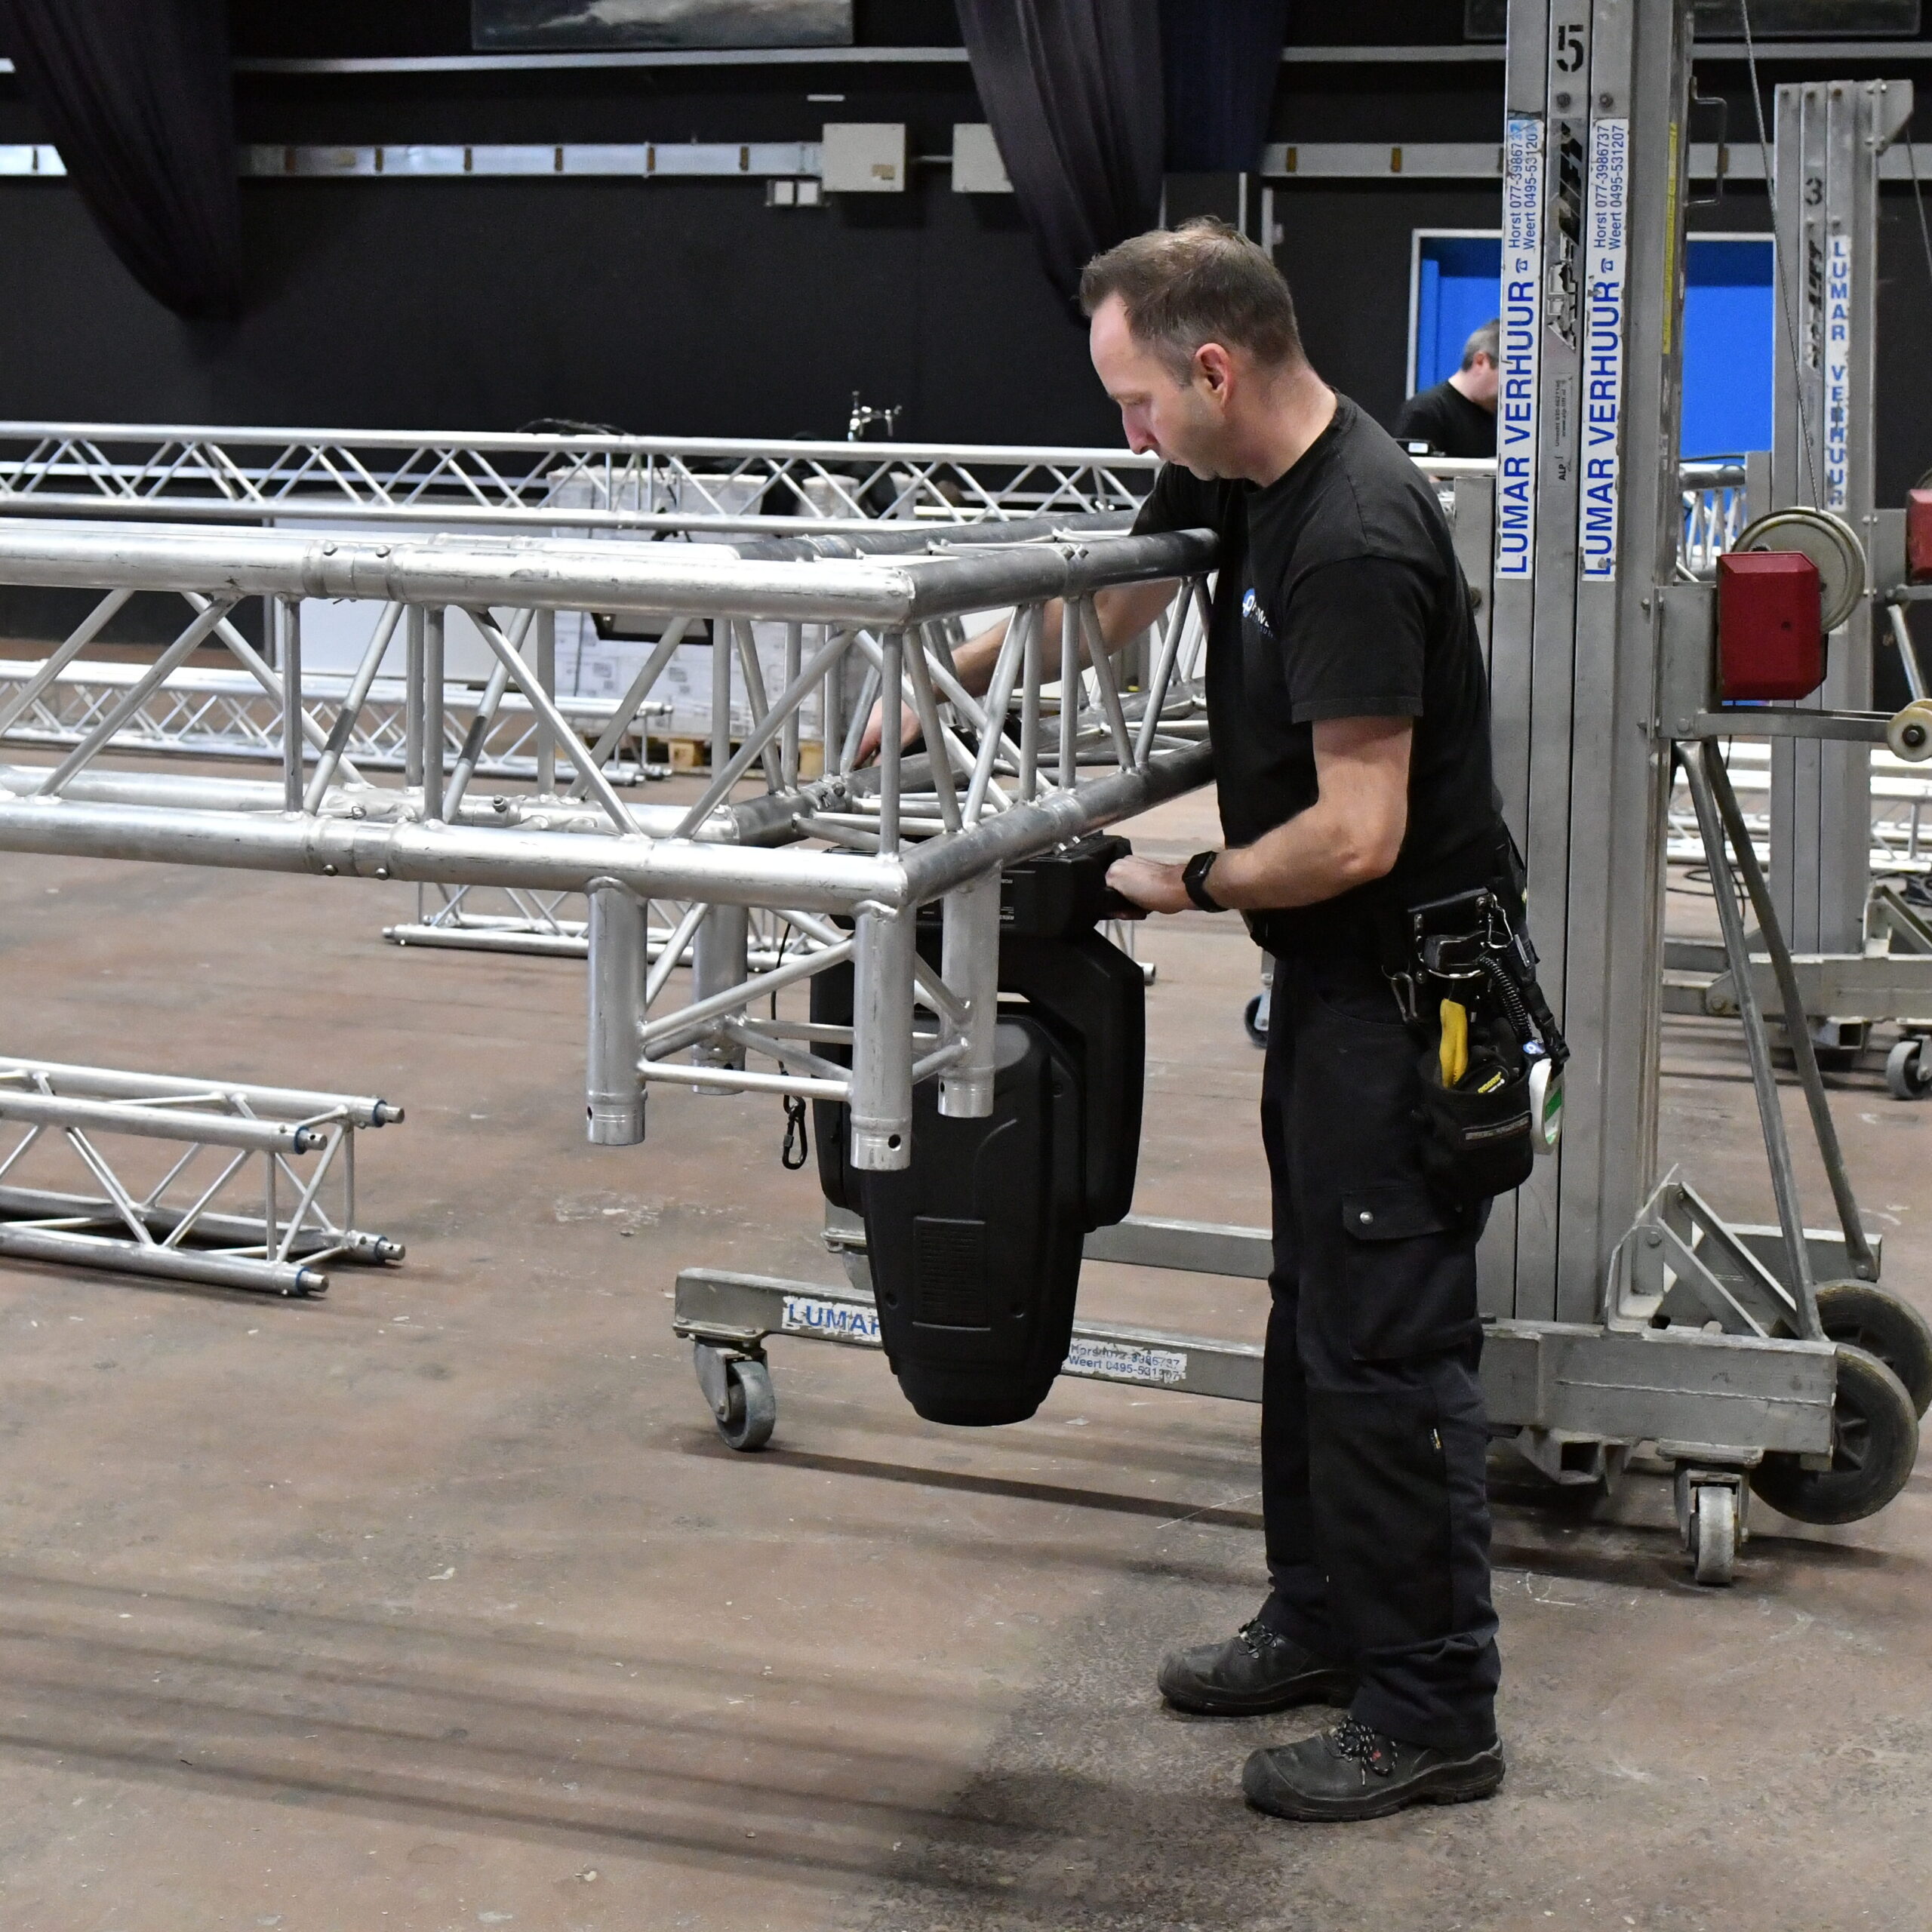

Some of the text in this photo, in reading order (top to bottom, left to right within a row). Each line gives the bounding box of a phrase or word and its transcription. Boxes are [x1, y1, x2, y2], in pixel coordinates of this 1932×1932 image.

[1556, 24, 1583, 72] 5
[1594, 125, 1609, 248] Horst 077-3986737
[1609, 125, 1624, 250] Weert 0495-531207
[1804, 177, 1823, 205] 3
[1509, 212, 1521, 248] Horst
[1523, 212, 1536, 250] Weert
[1831, 242, 1847, 340] LUMAR
[1501, 281, 1534, 573] LUMAR VERHUUR
[1585, 281, 1620, 574] LUMAR VERHUUR
[1069, 1355, 1102, 1369] Weert
